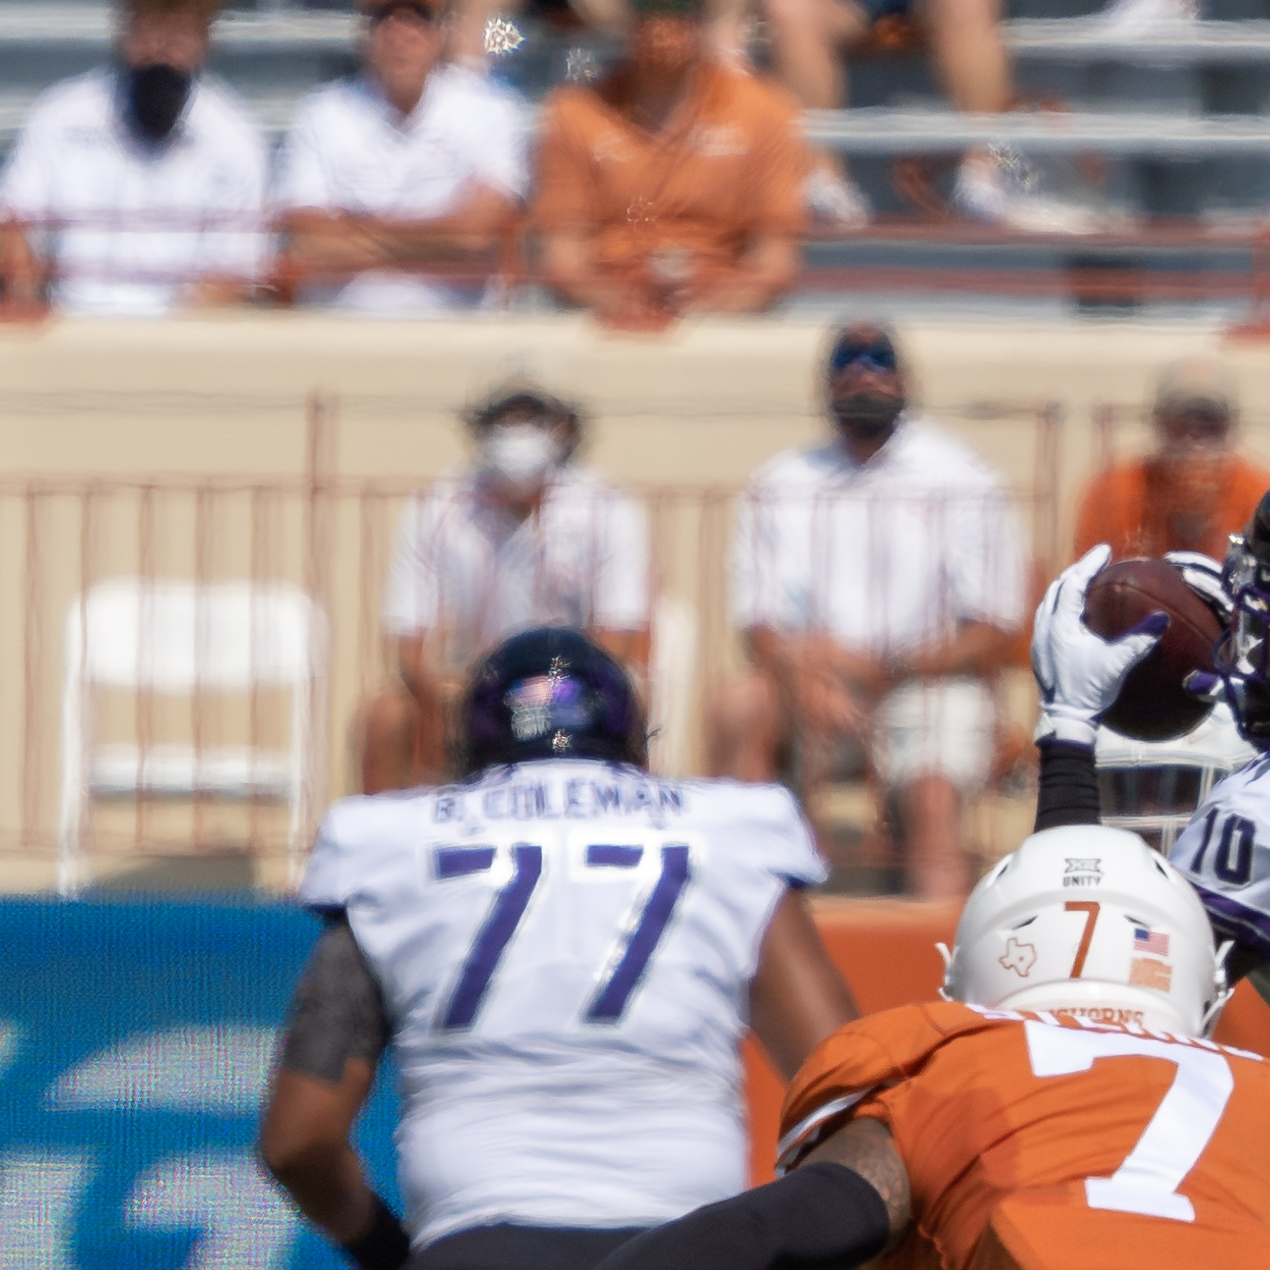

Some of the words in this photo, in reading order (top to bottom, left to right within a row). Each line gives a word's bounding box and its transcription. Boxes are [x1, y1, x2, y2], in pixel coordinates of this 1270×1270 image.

[1062, 875, 1102, 888] UNITY
[1189, 807, 1258, 887] 10
[430, 843, 692, 1030] 77
[1064, 901, 1101, 980] 7
[1024, 1020, 1235, 1224] 7
